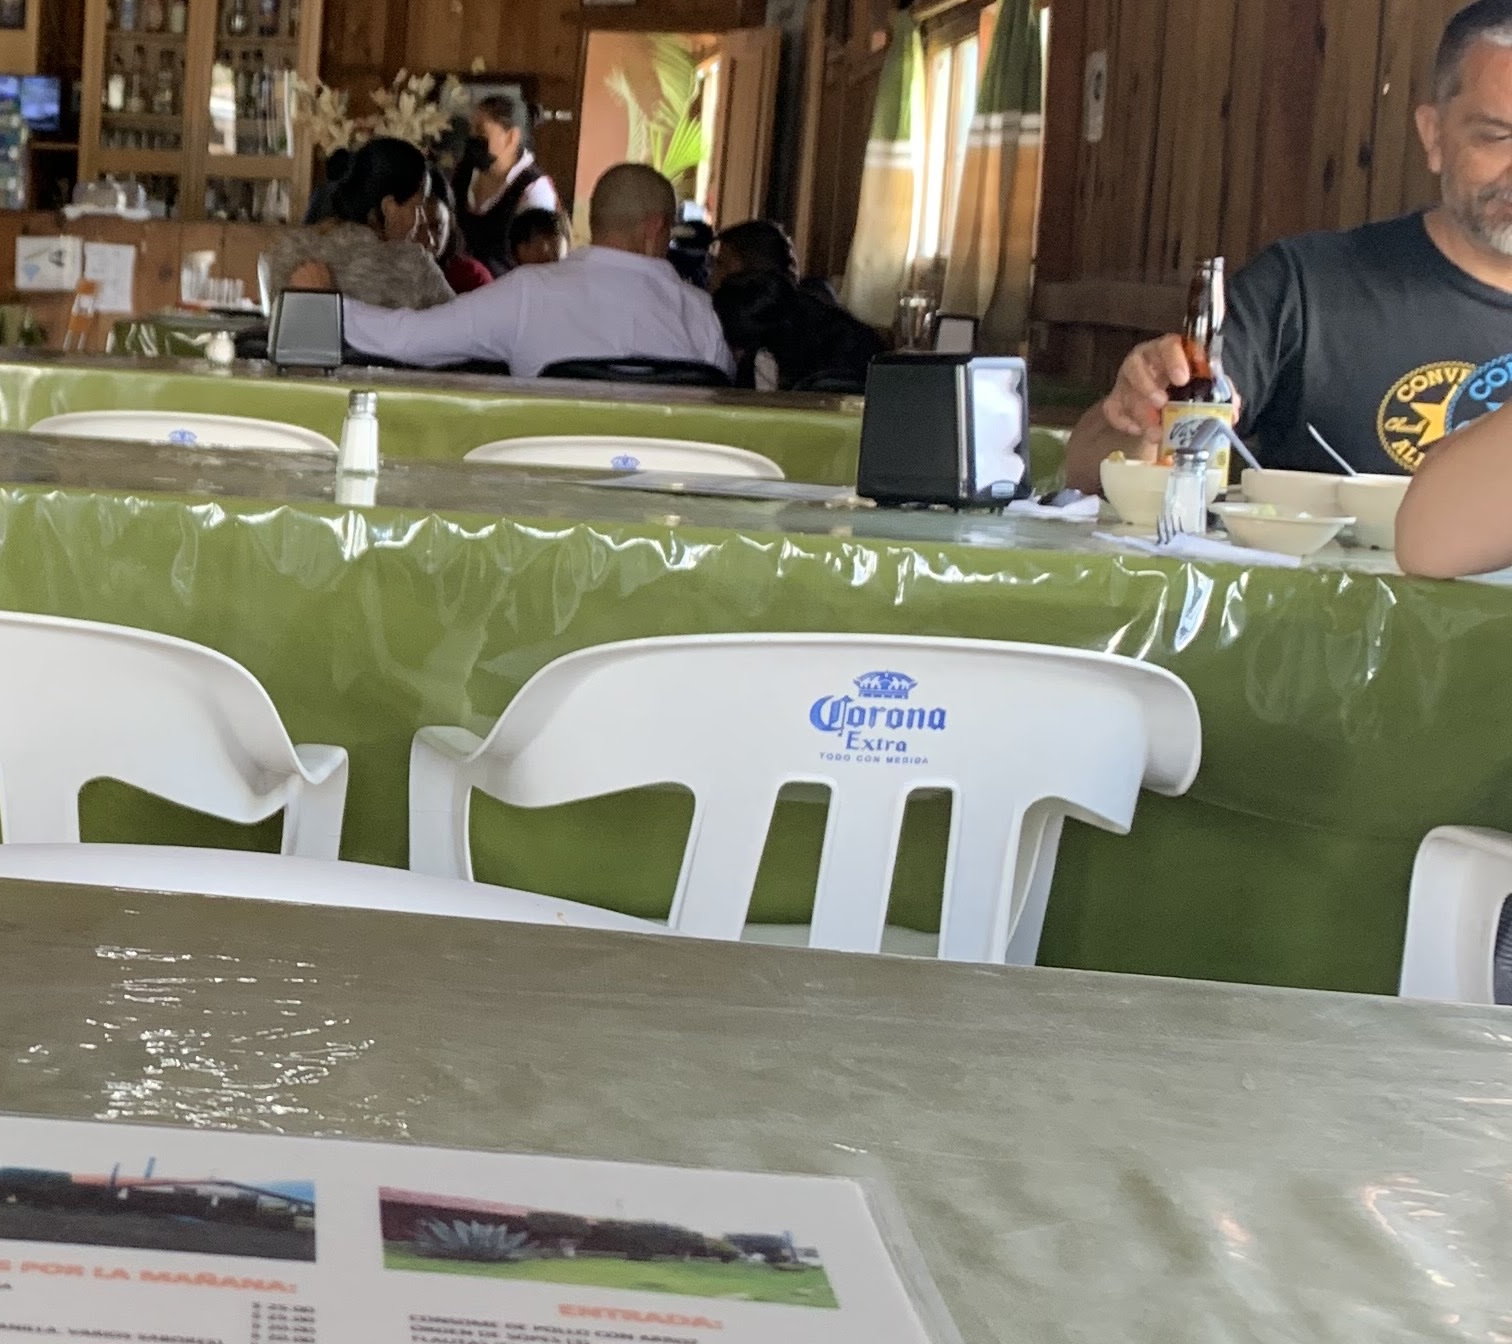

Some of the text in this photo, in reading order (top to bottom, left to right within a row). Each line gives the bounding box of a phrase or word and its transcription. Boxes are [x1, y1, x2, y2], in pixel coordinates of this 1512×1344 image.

[809, 695, 947, 737] Corona
[845, 730, 908, 753] Extra
[819, 752, 851, 762] TODO
[856, 754, 881, 763] CON
[20, 1260, 85, 1277] POR
[93, 1266, 130, 1280] LA
